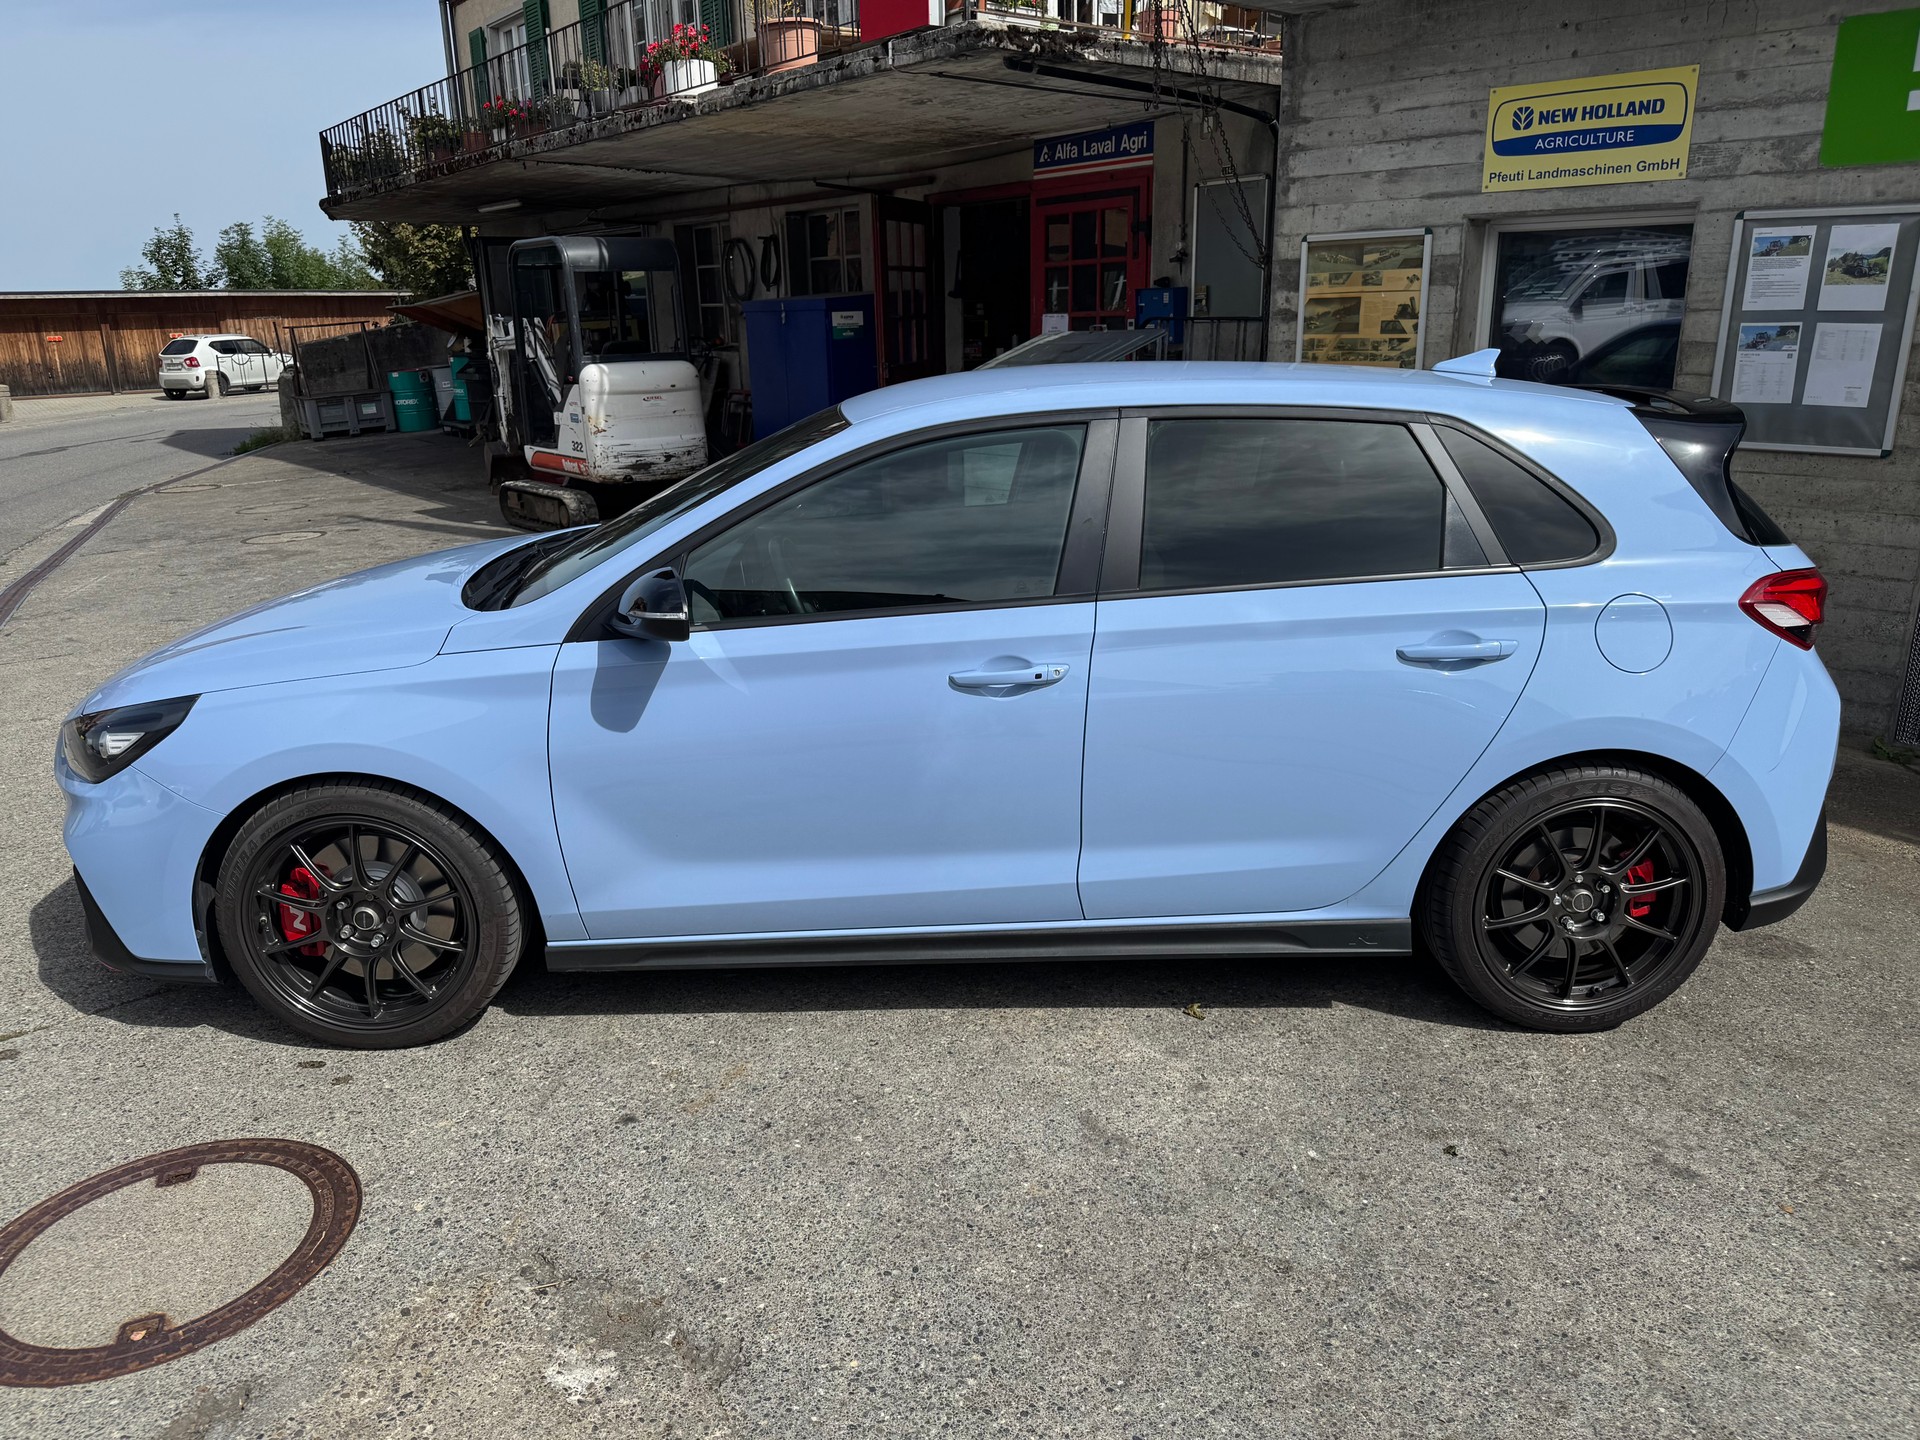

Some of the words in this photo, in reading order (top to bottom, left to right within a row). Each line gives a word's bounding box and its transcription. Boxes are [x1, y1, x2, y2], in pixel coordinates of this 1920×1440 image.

[1538, 106, 1578, 126] NEW
[1581, 98, 1665, 121] HOLLAND
[1054, 142, 1078, 160] Alfa
[1083, 136, 1115, 156] Laval
[1120, 131, 1147, 153] Agri
[1534, 130, 1635, 150] AGRICULTURE
[1488, 169, 1525, 183] Pfeuti
[1527, 164, 1632, 180] Landmaschinen
[1635, 158, 1681, 172] GmbH
[571, 441, 584, 453] 322
